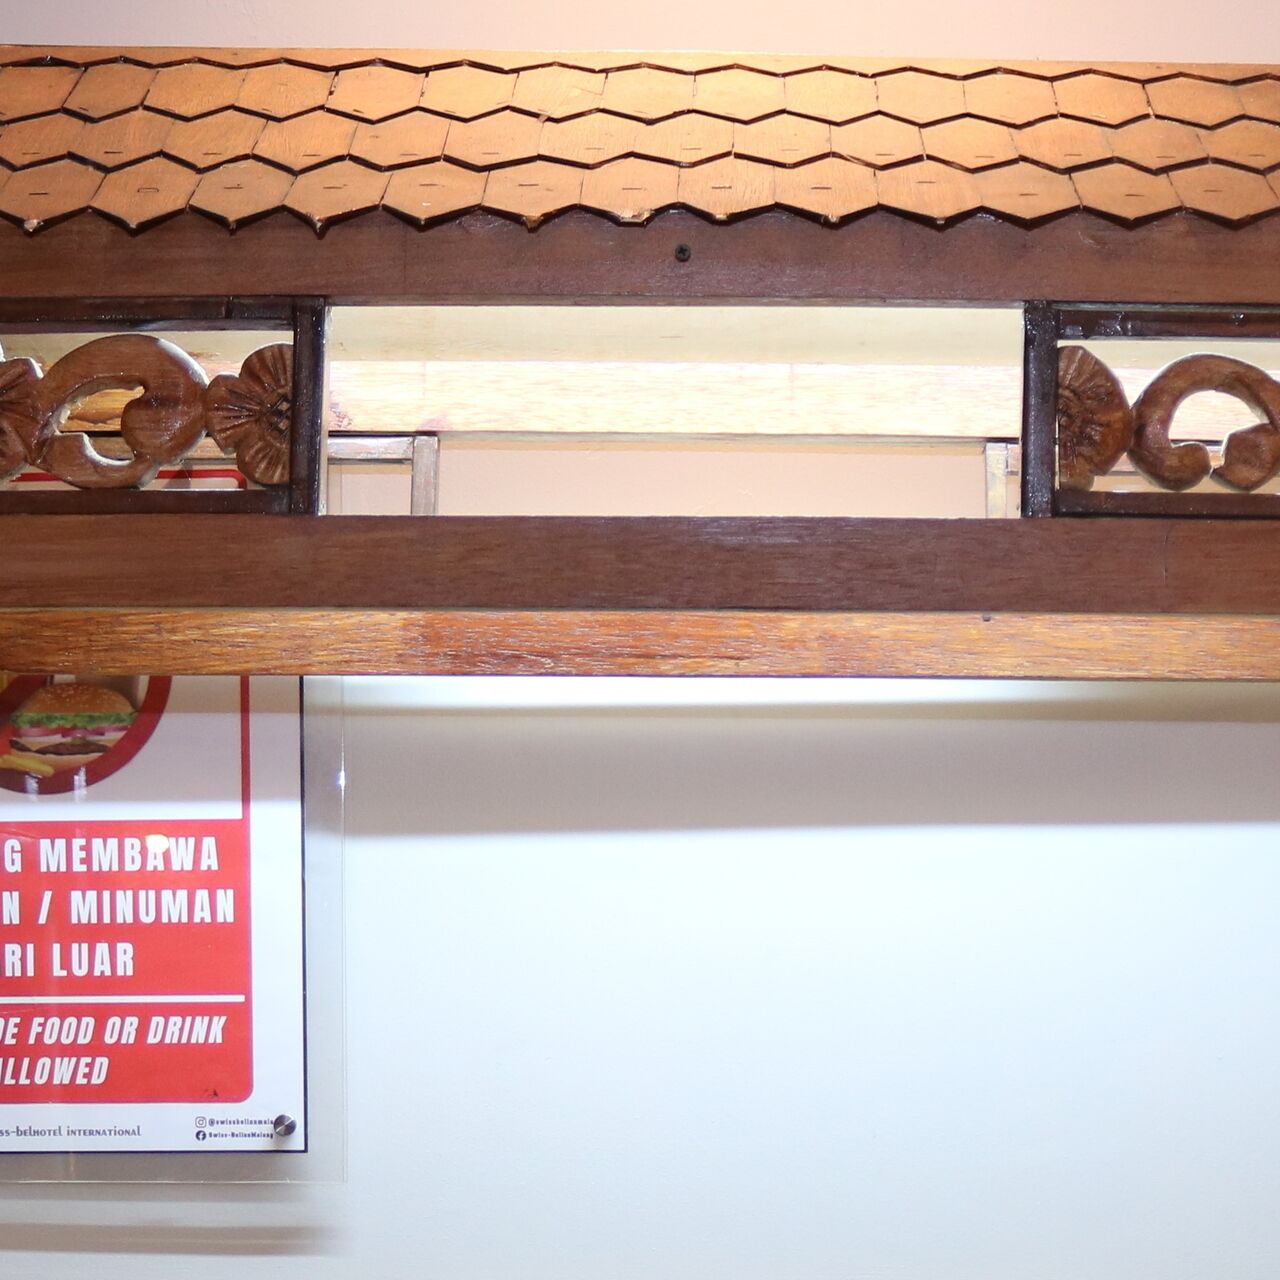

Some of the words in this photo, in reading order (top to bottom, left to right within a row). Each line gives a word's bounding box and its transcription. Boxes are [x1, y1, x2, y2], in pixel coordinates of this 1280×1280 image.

[39, 836, 220, 873] MEMBAWA
[37, 891, 53, 925] /
[70, 889, 235, 924] MINUMAN
[52, 942, 135, 977] LUAR
[27, 1016, 96, 1045] FOOD
[103, 1016, 139, 1045] OR
[146, 1015, 228, 1044] DRINK
